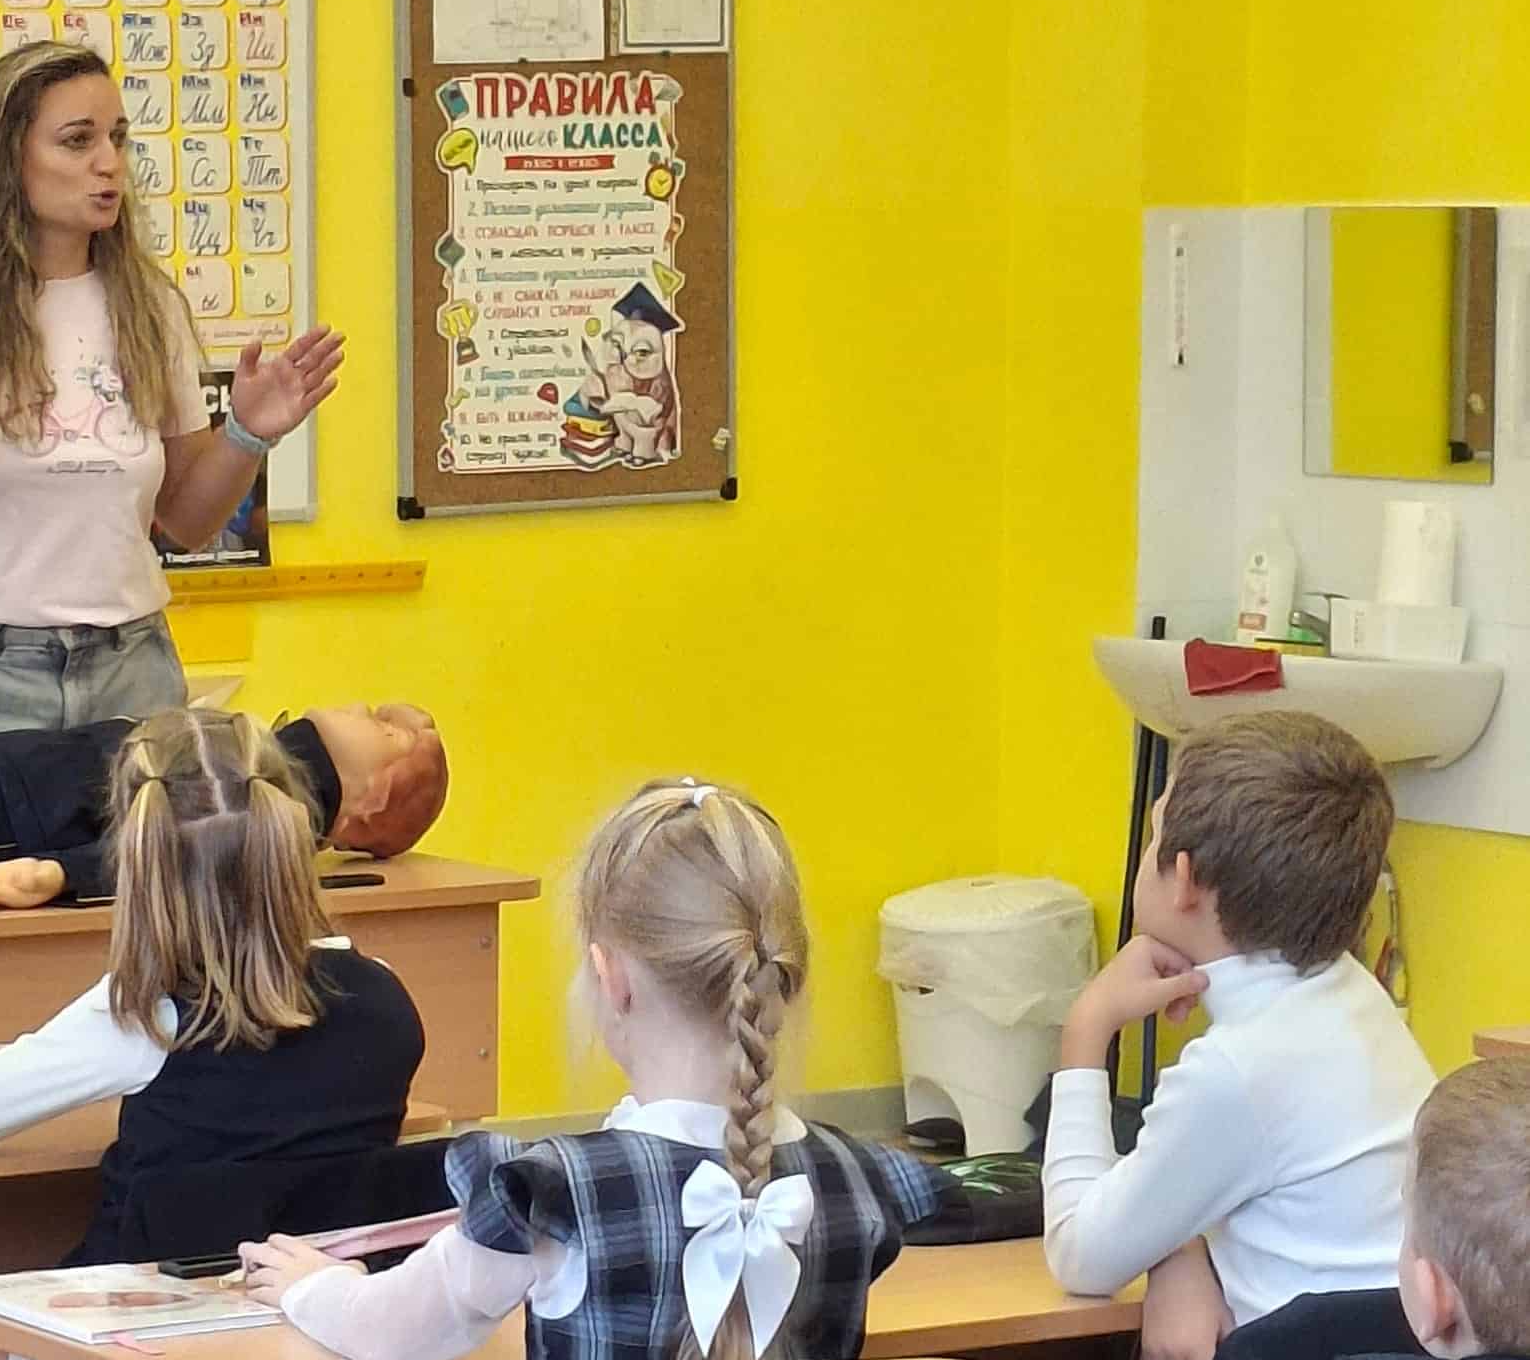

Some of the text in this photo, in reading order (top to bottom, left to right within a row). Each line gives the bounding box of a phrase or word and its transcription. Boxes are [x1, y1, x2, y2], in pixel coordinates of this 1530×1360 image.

[474, 75, 657, 118] ПРАВИЛА
[479, 121, 663, 152] нашего КЛАССА
